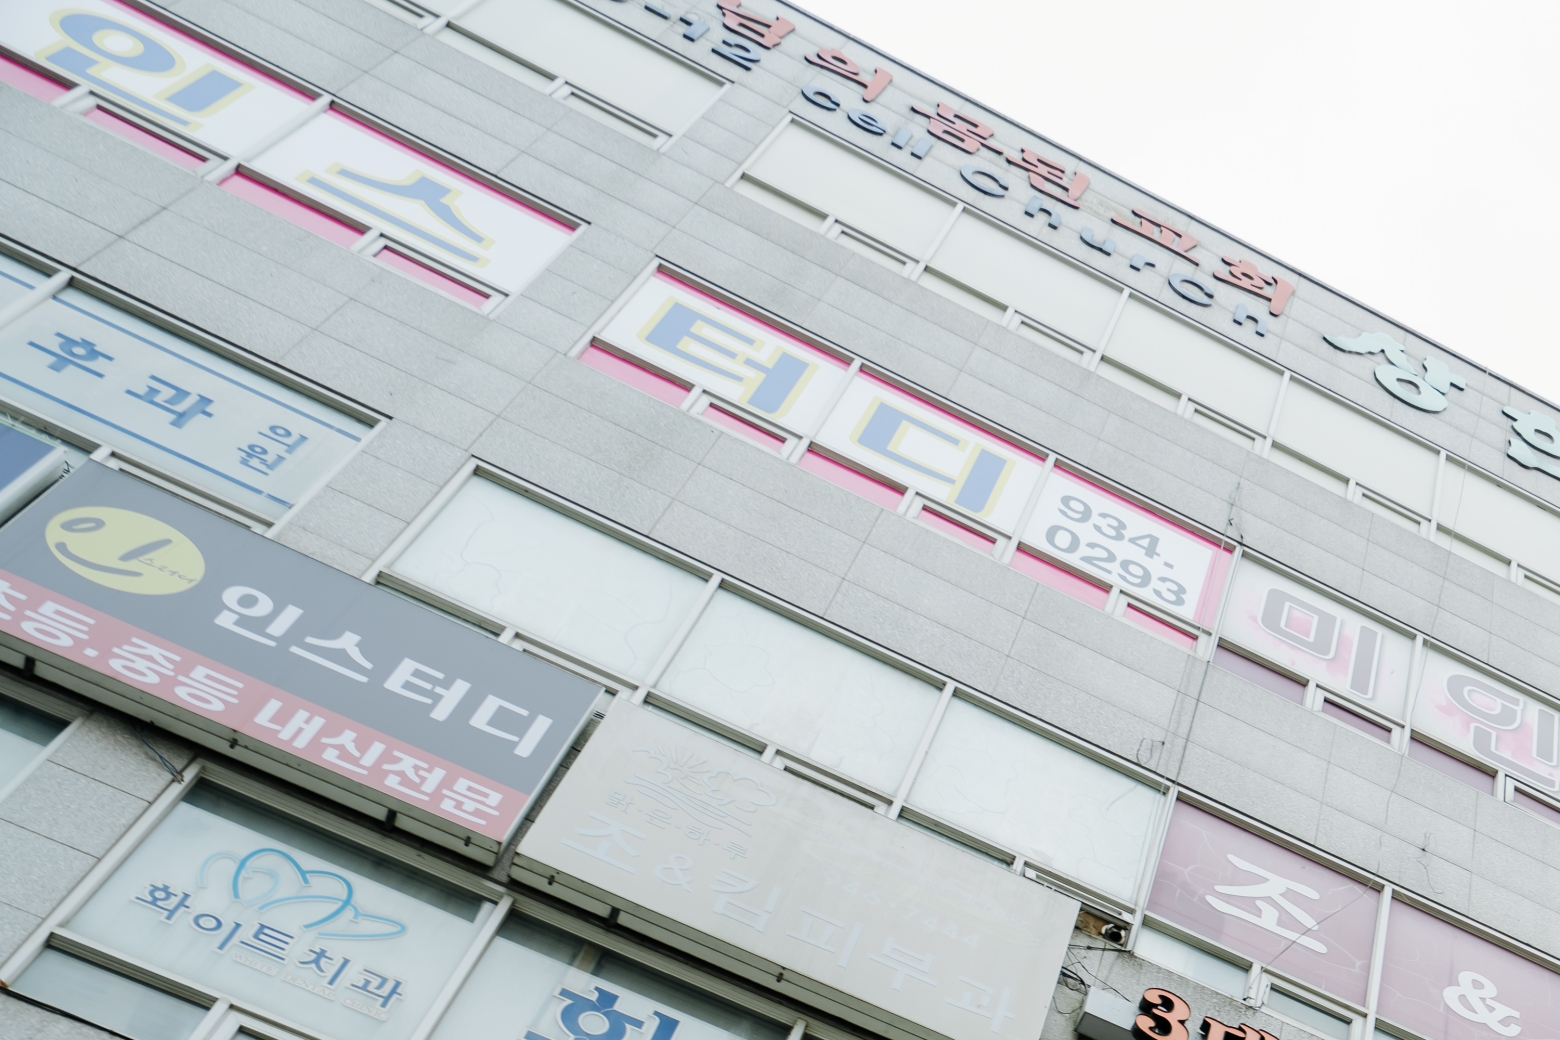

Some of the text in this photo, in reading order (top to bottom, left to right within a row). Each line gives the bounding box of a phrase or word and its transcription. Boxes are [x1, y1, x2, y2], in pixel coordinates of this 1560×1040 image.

[802, 85, 935, 160] cell
[1110, 209, 1295, 317] 교회
[1045, 525, 1188, 607] 0293
[213, 585, 553, 759] 인스터디
